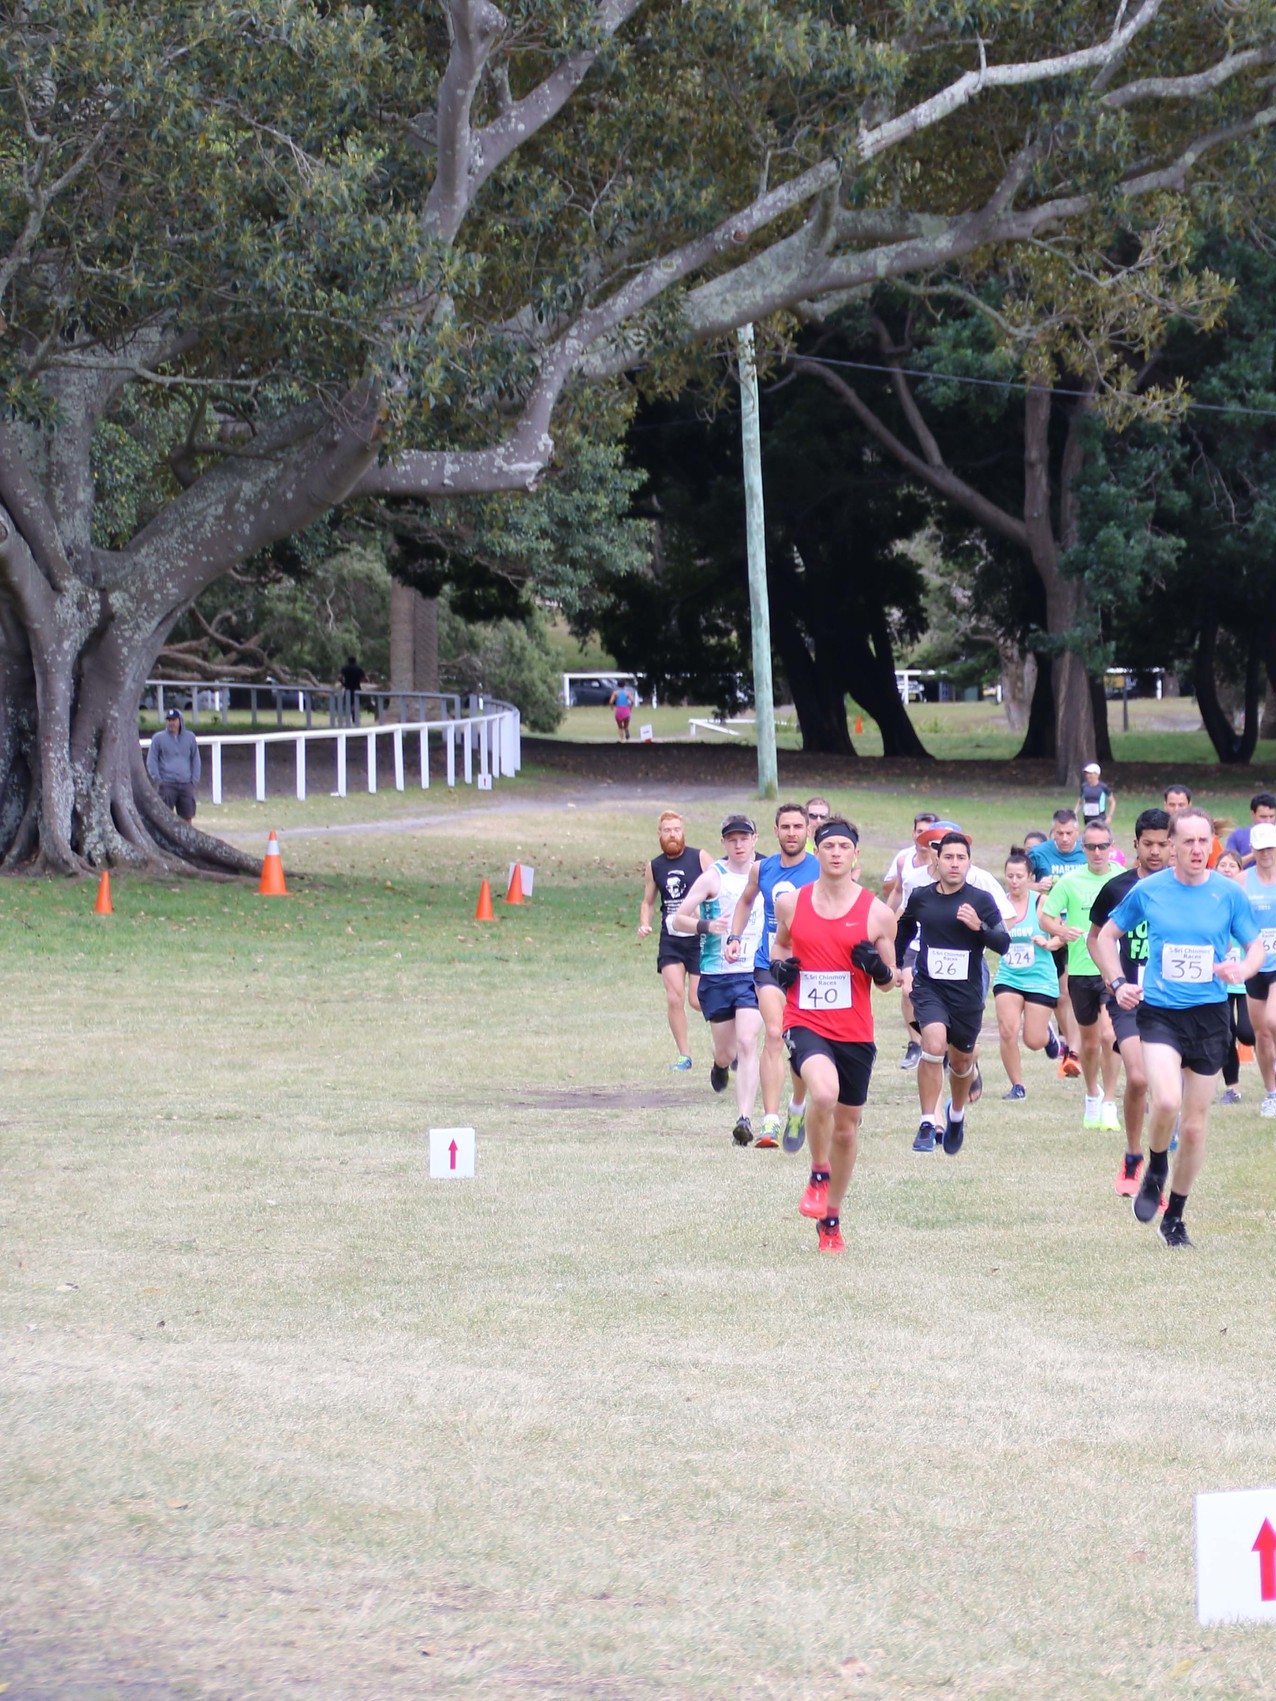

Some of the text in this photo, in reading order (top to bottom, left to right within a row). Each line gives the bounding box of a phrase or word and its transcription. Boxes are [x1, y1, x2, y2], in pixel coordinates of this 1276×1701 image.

[1006, 952, 1031, 965] 224
[934, 960, 957, 975] 26
[1171, 959, 1202, 979] 35
[807, 988, 838, 1008] 40
